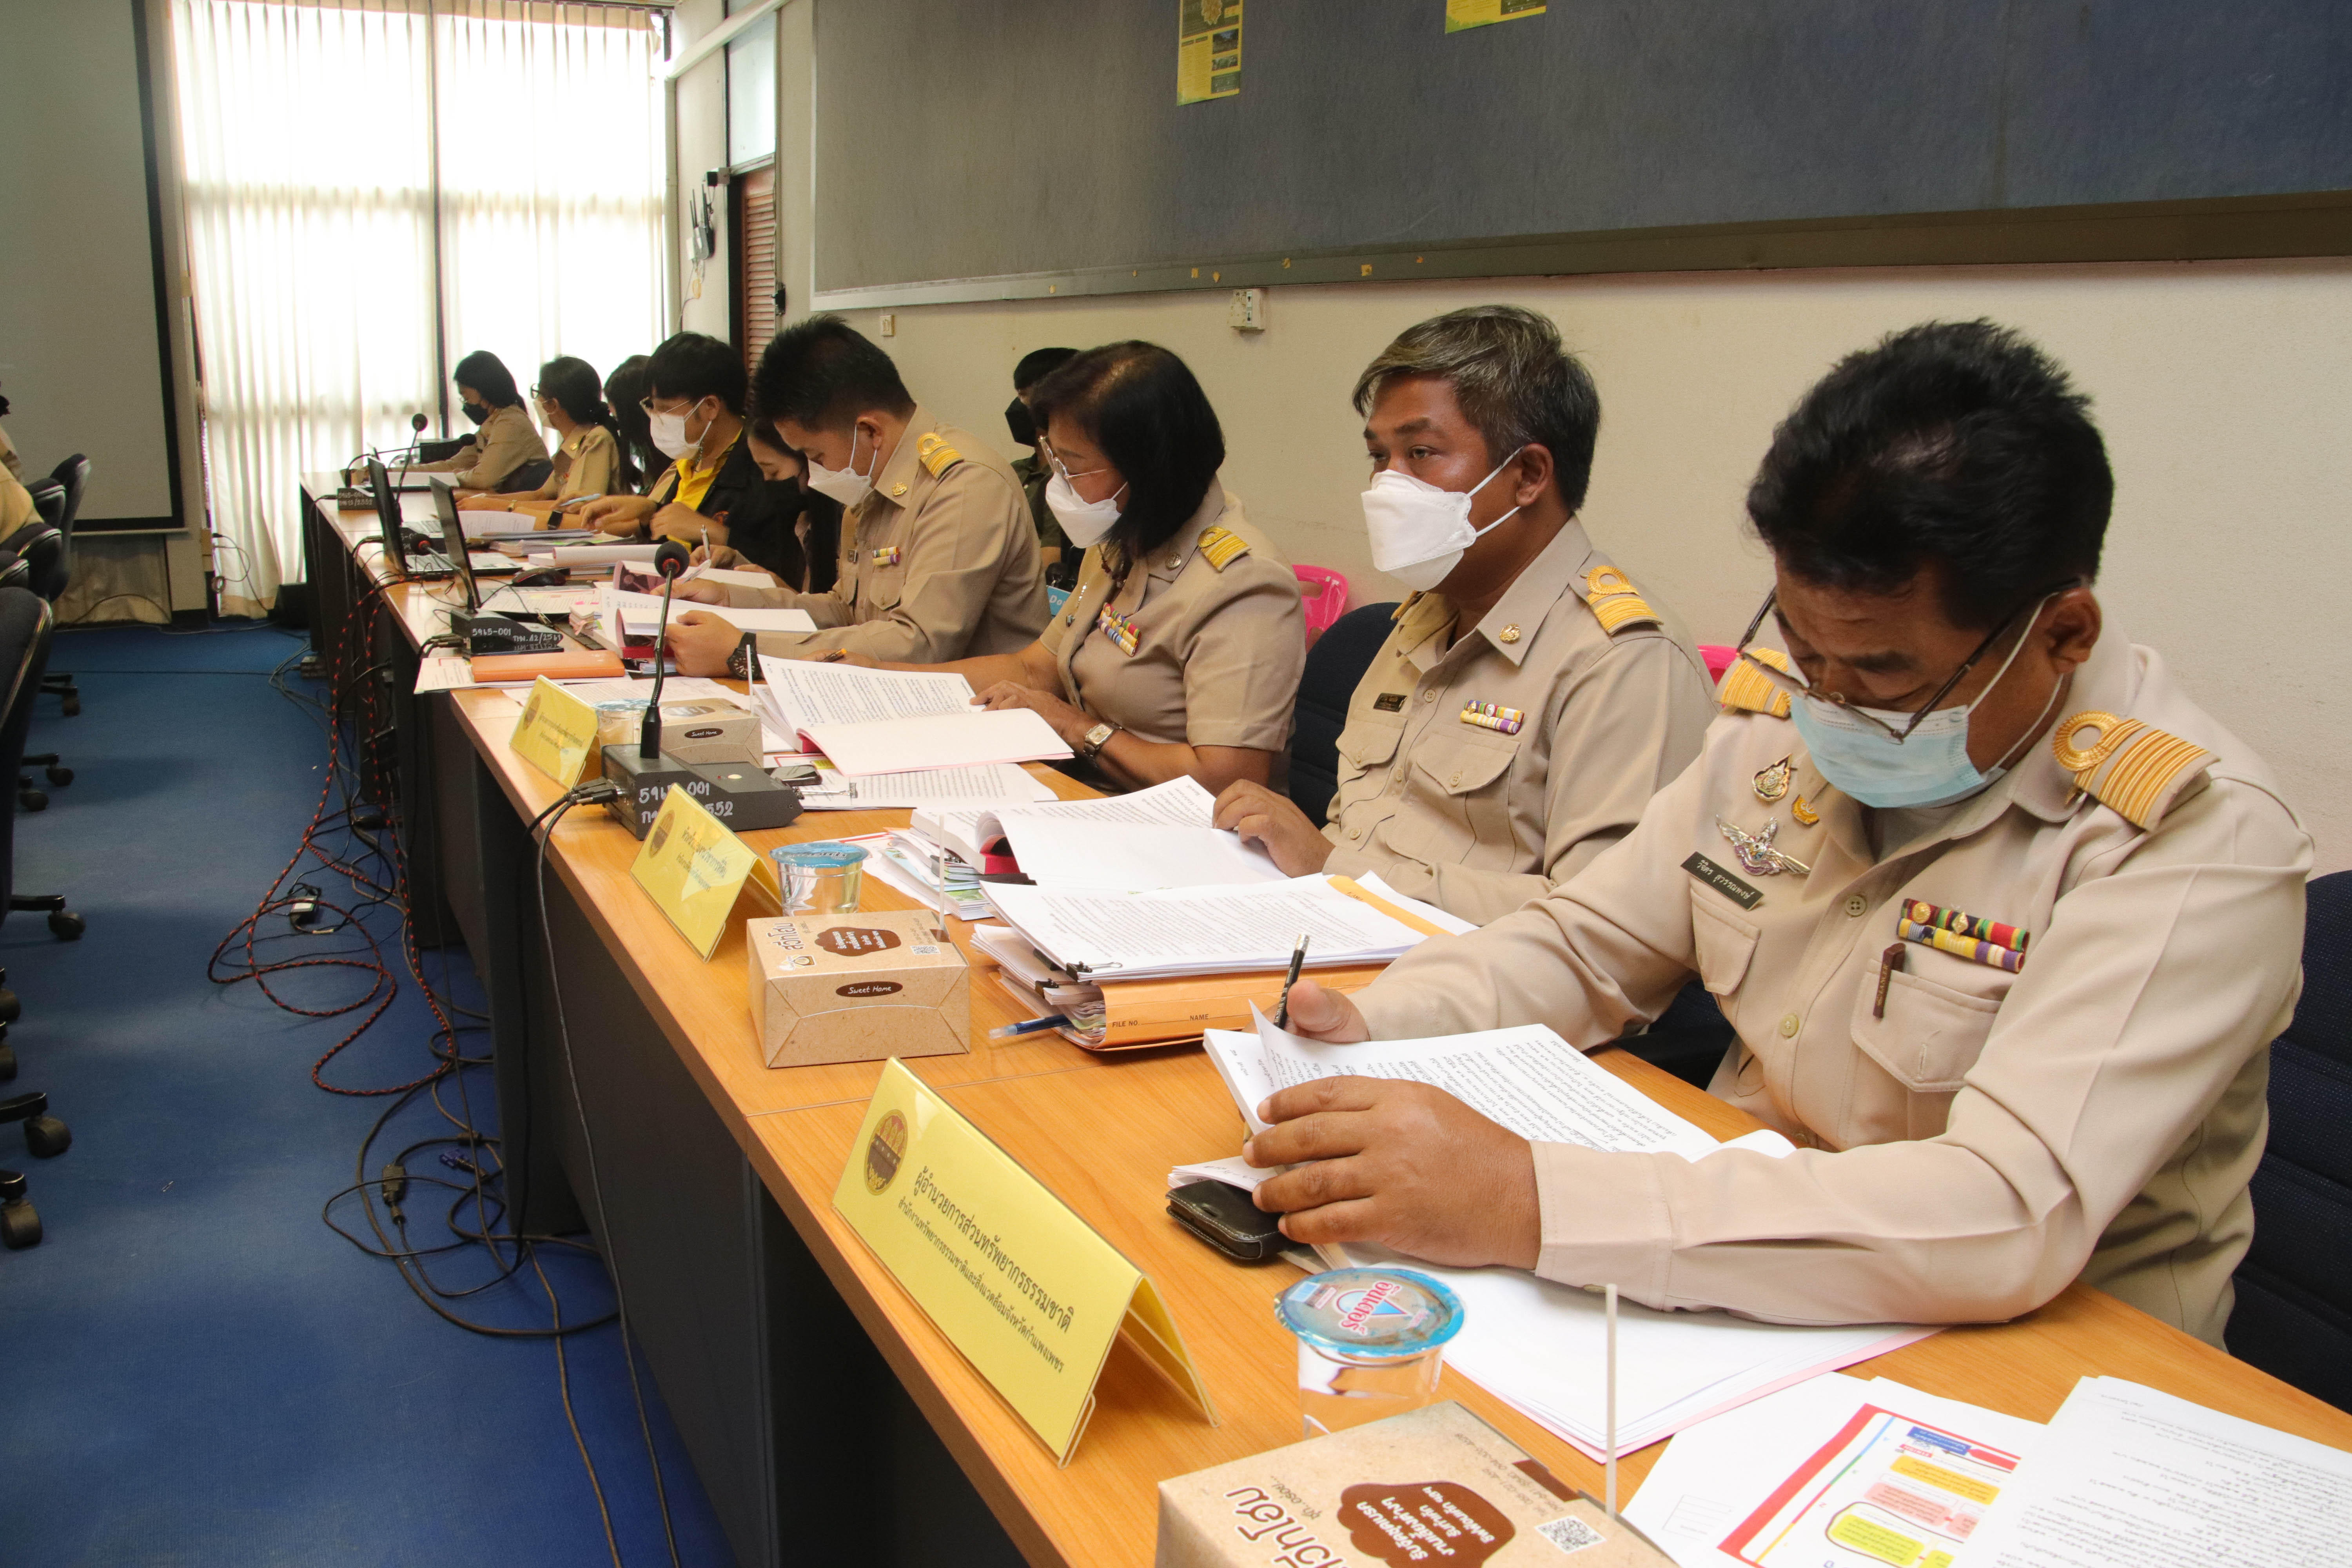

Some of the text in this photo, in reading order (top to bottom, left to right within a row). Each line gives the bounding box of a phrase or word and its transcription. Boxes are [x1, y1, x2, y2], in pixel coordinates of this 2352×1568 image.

[767, 922, 805, 951] สวีทโฮม
[848, 984, 892, 995] Sweet Home
[914, 1165, 1074, 1334] ผู้อำนวยการส่วนทรัพยากรธรรมชาติ
[898, 1198, 1065, 1374] สำนักงานทรัพยากรธรรมชาติและสิ่งแวดล้อมจังหวัดกำแพงเพชร
[1343, 1281, 1399, 1333] อินเตอร์
[1419, 1504, 1462, 1537] รับทำเค้ก
[1422, 1486, 1444, 1503] ฯลฯ
[1226, 1487, 1348, 1568] วีทโฮม
[1356, 1501, 1428, 1560] รับจัดชุดเบรค
[1381, 1497, 1455, 1556] งานเลี้ยงต่างๆ
